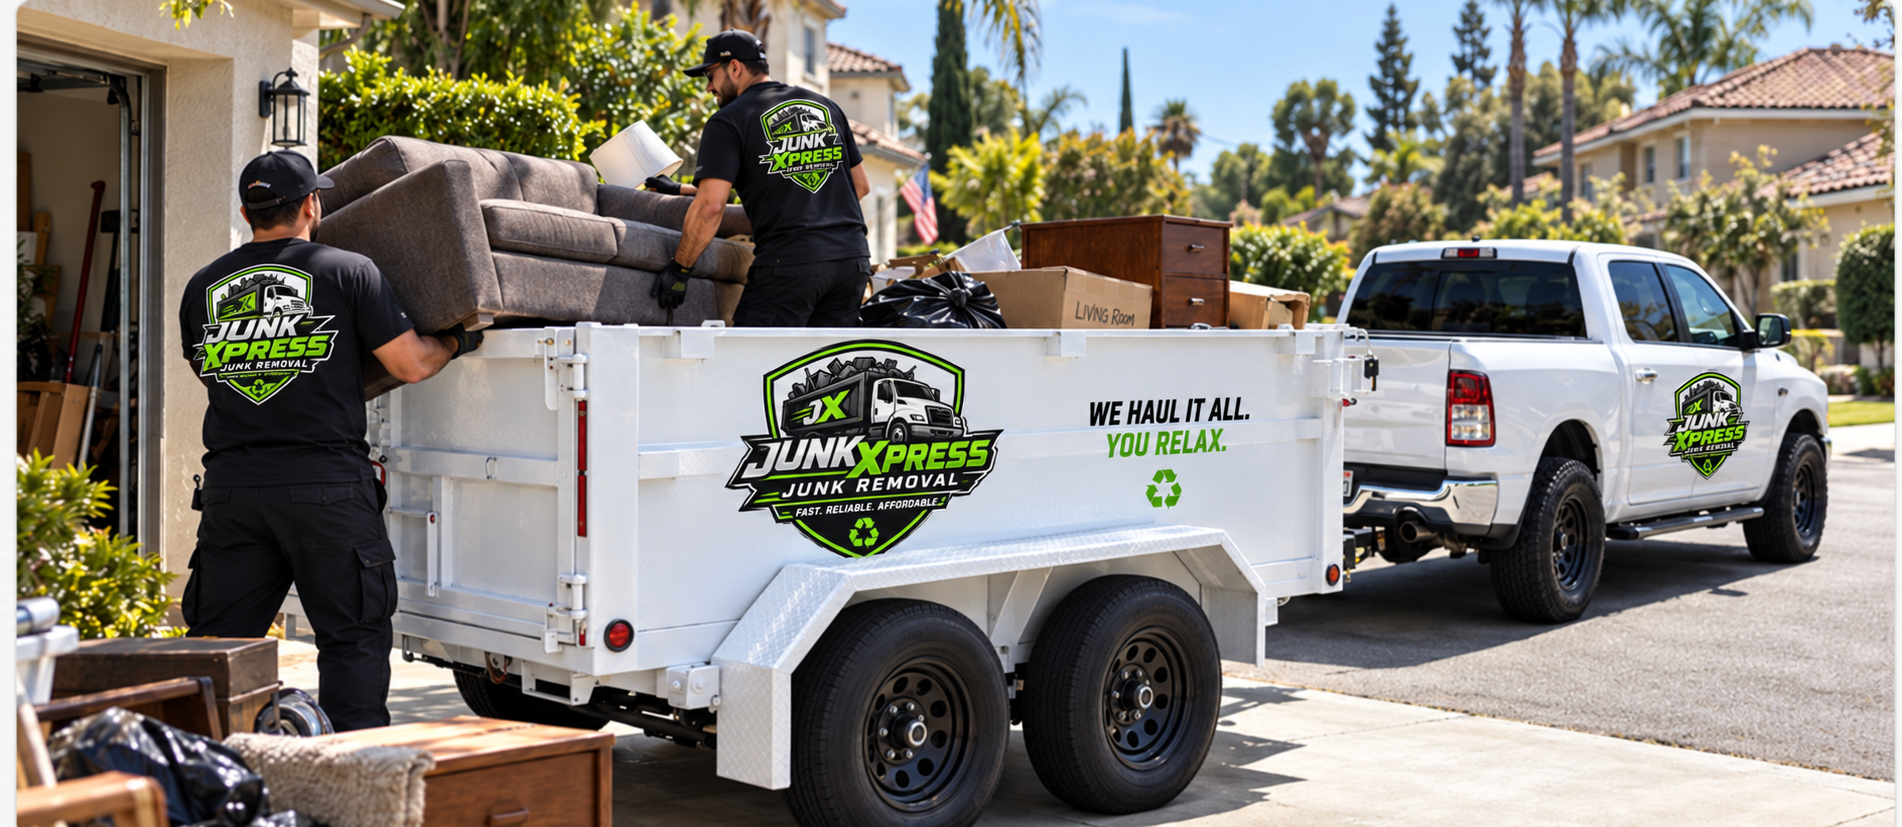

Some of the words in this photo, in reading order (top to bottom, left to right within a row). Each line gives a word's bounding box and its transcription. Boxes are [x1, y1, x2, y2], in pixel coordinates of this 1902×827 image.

[773, 132, 826, 154] JUNK
[771, 146, 842, 172] XPRESS
[1075, 301, 1109, 324] LIVING
[205, 314, 305, 343] JUNK
[202, 335, 330, 372] XPRESS
[220, 362, 253, 372] JUNK
[255, 359, 308, 369] REMOVAL
[803, 389, 850, 426] JX
[1089, 401, 1123, 426] WE
[1126, 399, 1180, 425] HAUL
[1185, 398, 1206, 422] IT
[1208, 396, 1250, 422] ALL.
[1676, 411, 1731, 433] JUNK
[1106, 432, 1150, 458] YOU
[1155, 428, 1227, 456] RELAX.
[1673, 425, 1745, 452] XPRESS
[781, 479, 847, 498] JUNK
[855, 473, 958, 493] REMOVAL
[795, 506, 823, 518] FAST.
[825, 502, 875, 515] RELIABLE.
